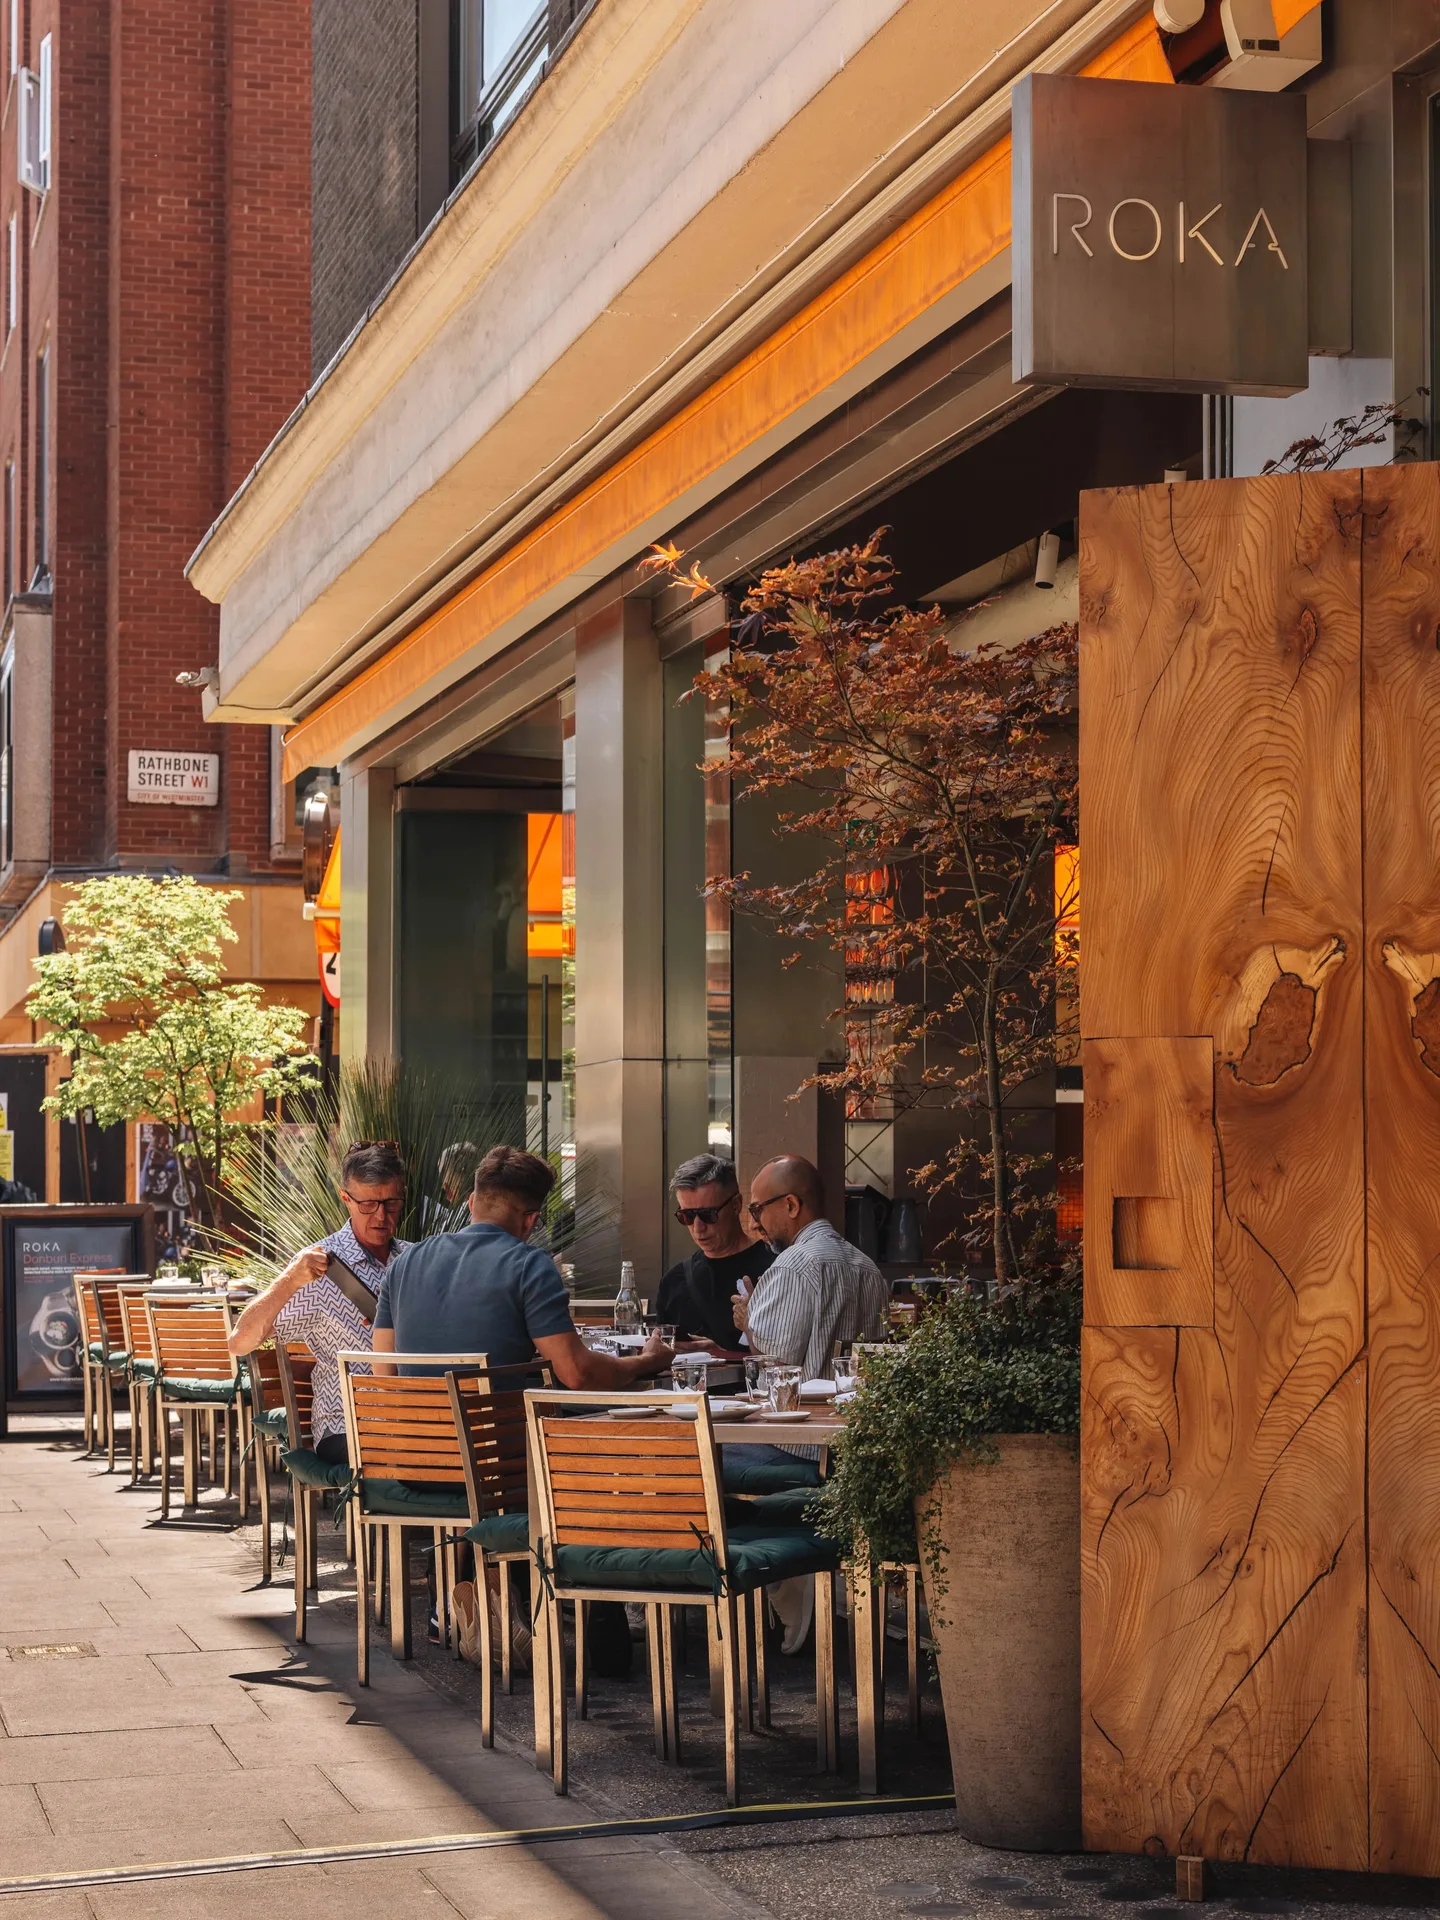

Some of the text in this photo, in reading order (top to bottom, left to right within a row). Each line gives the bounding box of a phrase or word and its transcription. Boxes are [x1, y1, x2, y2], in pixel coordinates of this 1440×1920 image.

[1053, 192, 1289, 270] ROKA
[138, 756, 209, 772] RATHBONE
[138, 772, 209, 789] STREET W1
[137, 792, 150, 800] CITY
[162, 794, 205, 802] WESTMINSTER
[23, 1242, 60, 1252] ROKA
[23, 1252, 113, 1264] Donburi Express
